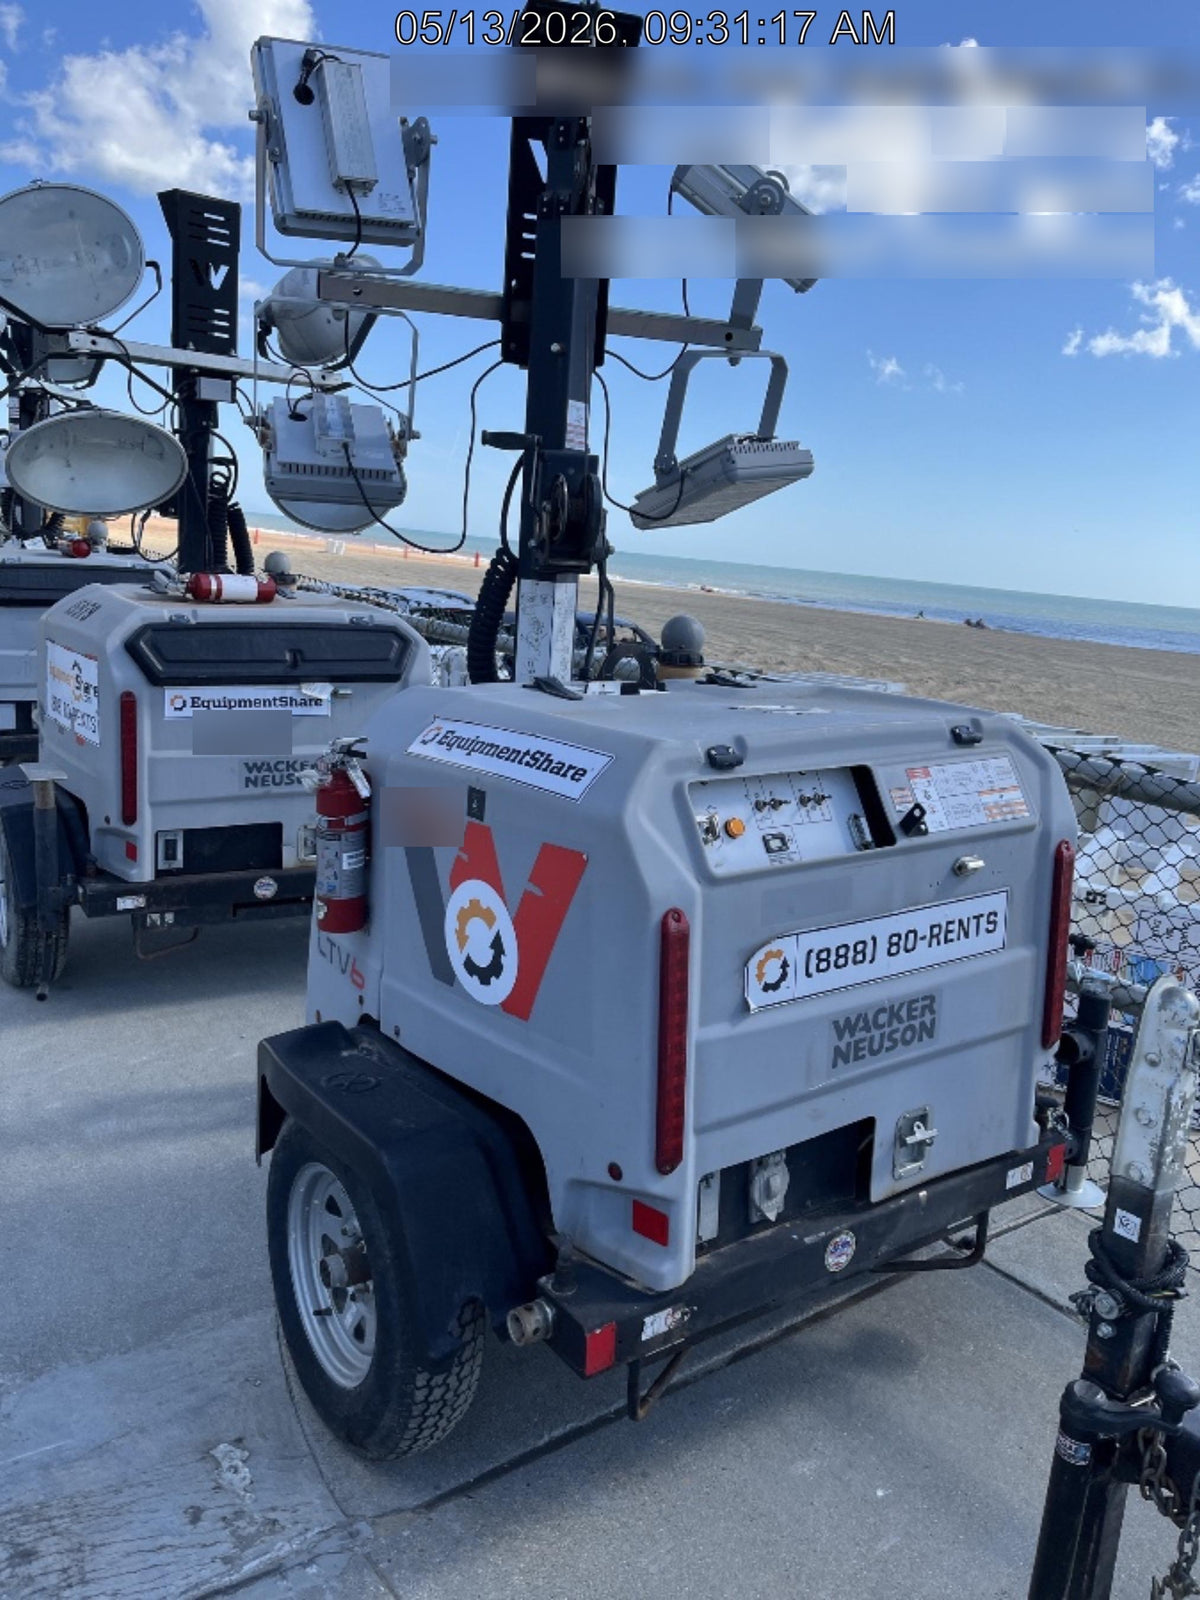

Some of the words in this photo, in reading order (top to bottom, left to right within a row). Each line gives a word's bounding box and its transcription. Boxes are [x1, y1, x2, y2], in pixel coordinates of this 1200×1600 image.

[190, 696, 323, 710] EquipmentShare
[438, 730, 587, 782] EquipmentShare
[805, 936, 877, 978] (888)
[887, 912, 997, 956] 80-RENTS
[831, 1017, 937, 1069] NEUSON
[832, 994, 937, 1041] WACKER
